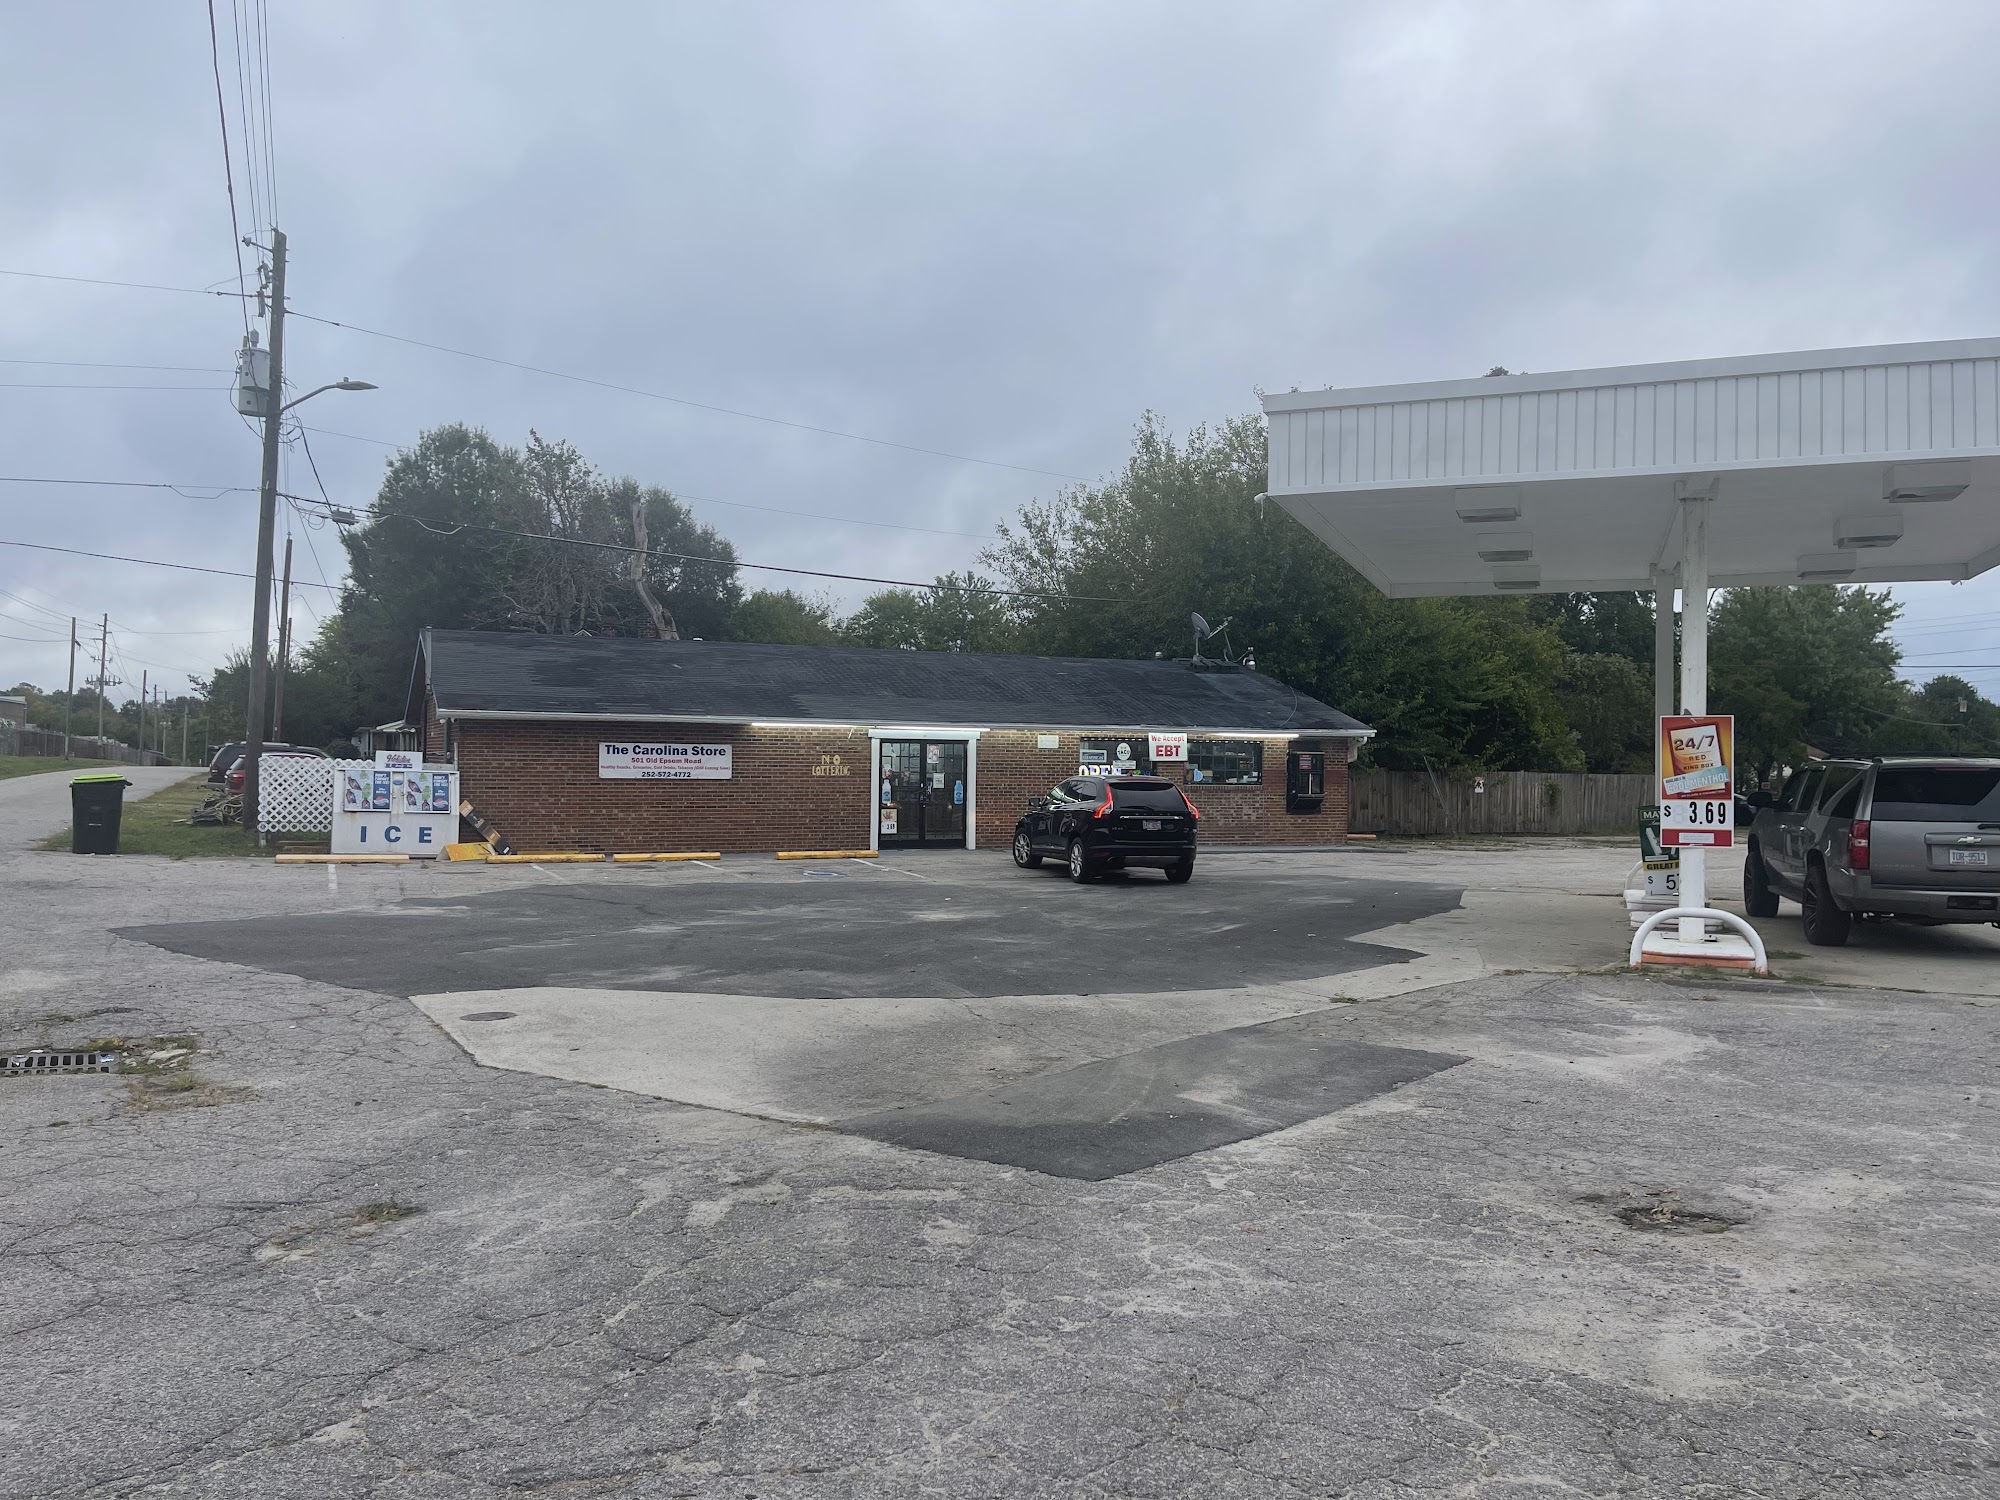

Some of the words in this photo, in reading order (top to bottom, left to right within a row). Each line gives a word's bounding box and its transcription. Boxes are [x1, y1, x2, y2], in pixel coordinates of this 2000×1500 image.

[1163, 735, 1185, 743] Accept
[1674, 735, 1714, 751] 24/7
[604, 744, 629, 755] The
[632, 744, 688, 756] Carolina
[691, 745, 727, 756] Store
[1155, 745, 1181, 757] EBT
[821, 754, 841, 765] NO
[1690, 772, 1729, 788] MENTHOL
[1663, 805, 1672, 817] $
[1689, 801, 1726, 825] 3.69
[360, 825, 432, 843] ICE
[1646, 862, 1674, 870] GREAT
[1647, 875, 1654, 885] $
